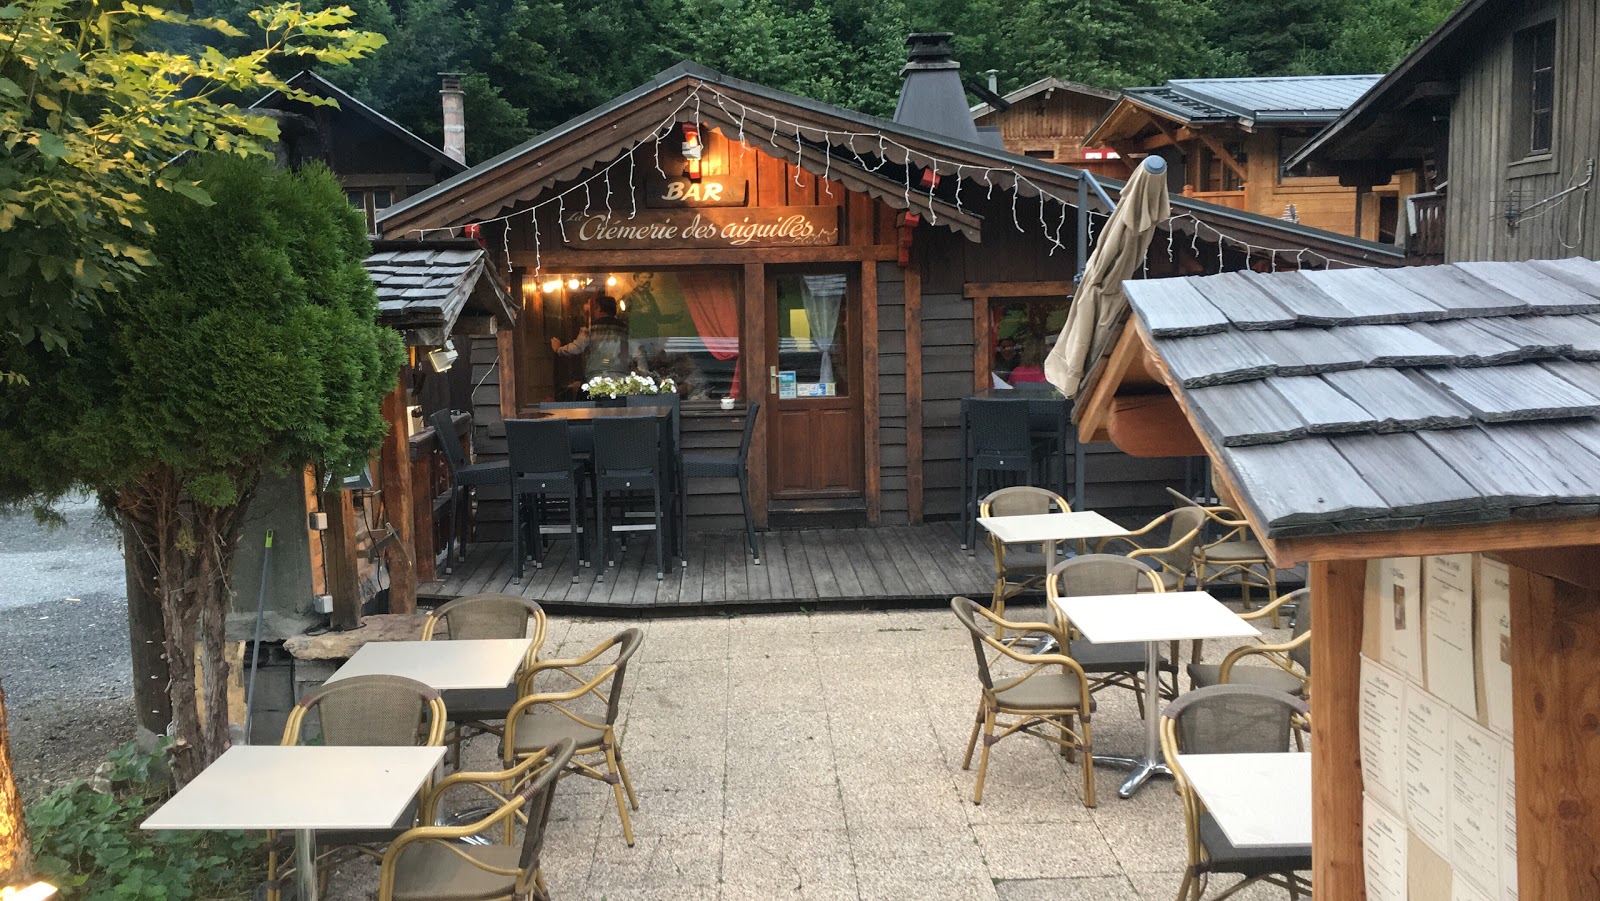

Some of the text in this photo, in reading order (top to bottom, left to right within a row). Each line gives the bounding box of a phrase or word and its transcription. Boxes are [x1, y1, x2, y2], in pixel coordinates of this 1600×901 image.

[661, 182, 723, 201] BAR
[579, 214, 678, 241] Crémerie
[682, 213, 717, 240] des
[720, 214, 814, 246] aiguilles
